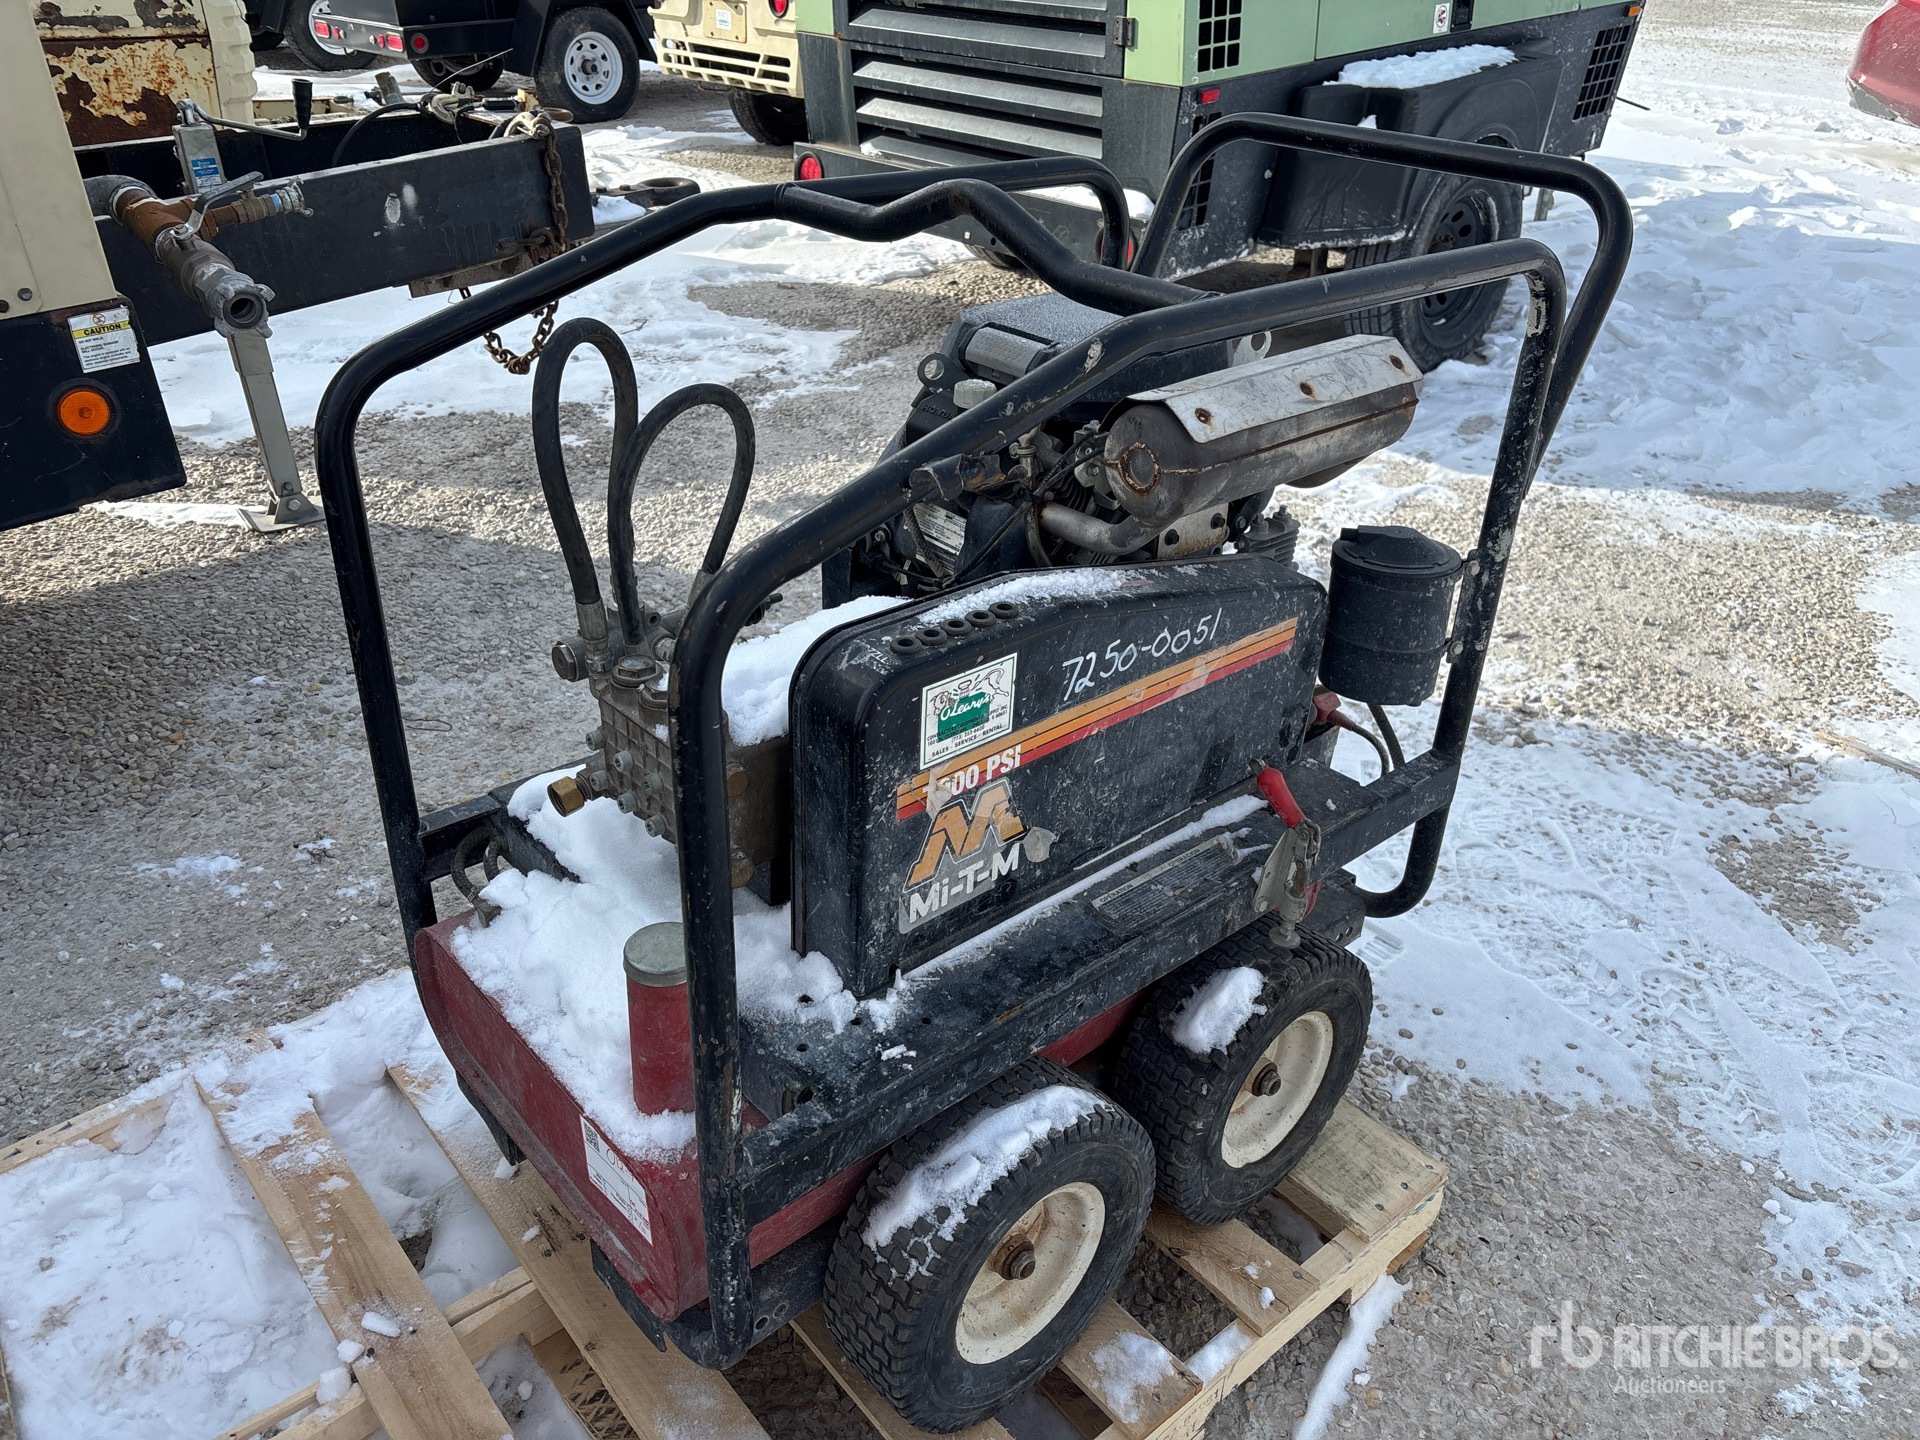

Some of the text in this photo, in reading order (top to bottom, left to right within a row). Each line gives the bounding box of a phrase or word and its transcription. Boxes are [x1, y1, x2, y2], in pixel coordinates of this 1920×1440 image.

[83, 324, 122, 336] CAUTION
[1062, 607, 1223, 701] 7250-0051
[931, 724, 1003, 758] SALES SERVICE RENTAL
[986, 744, 1021, 781] PSI
[909, 842, 1020, 924] Mi-T-M
[1099, 883, 1134, 903] OPERATION
